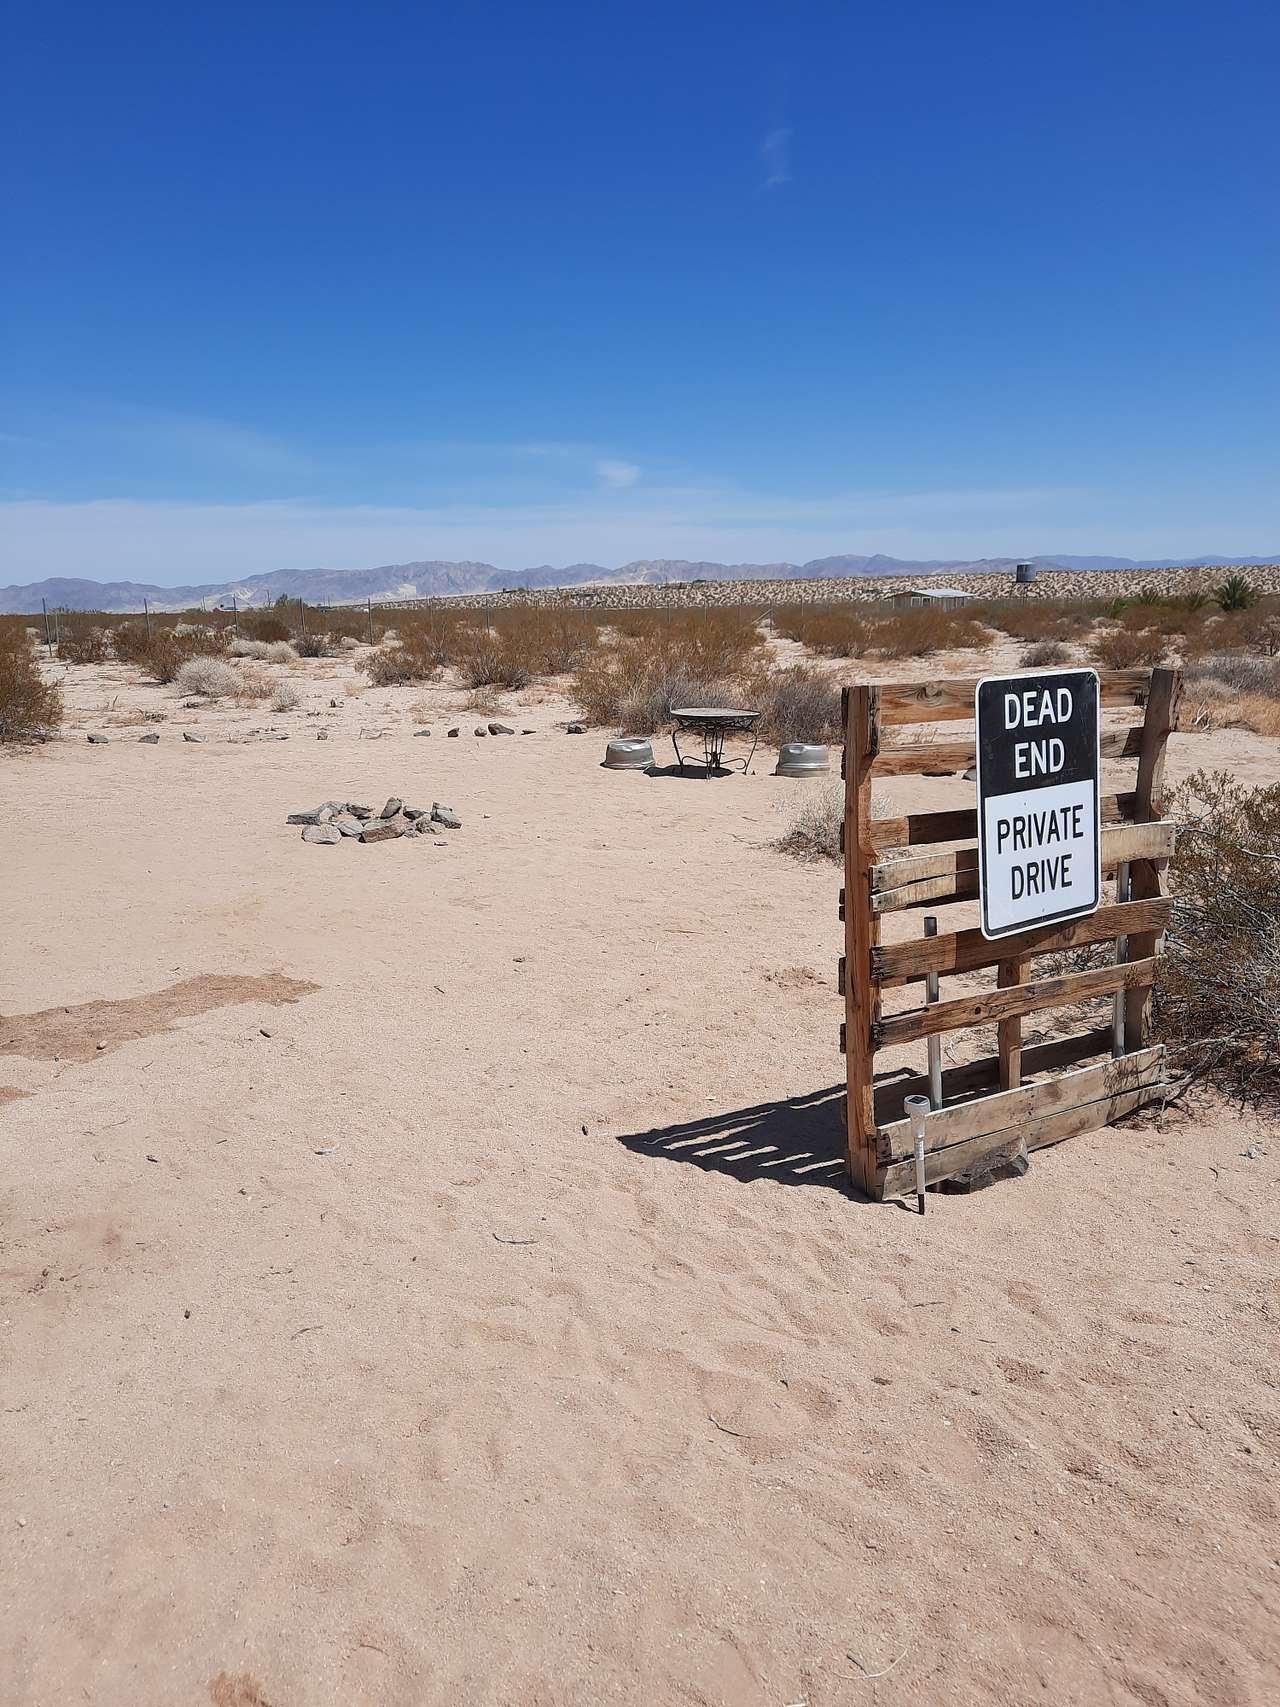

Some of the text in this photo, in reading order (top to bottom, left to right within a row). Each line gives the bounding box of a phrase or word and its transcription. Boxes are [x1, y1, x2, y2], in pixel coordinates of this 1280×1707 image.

[1004, 688, 1073, 730] DEAD
[1015, 738, 1065, 779] END
[997, 804, 1084, 855] PRIVATE
[1011, 853, 1073, 900] DRIVE
